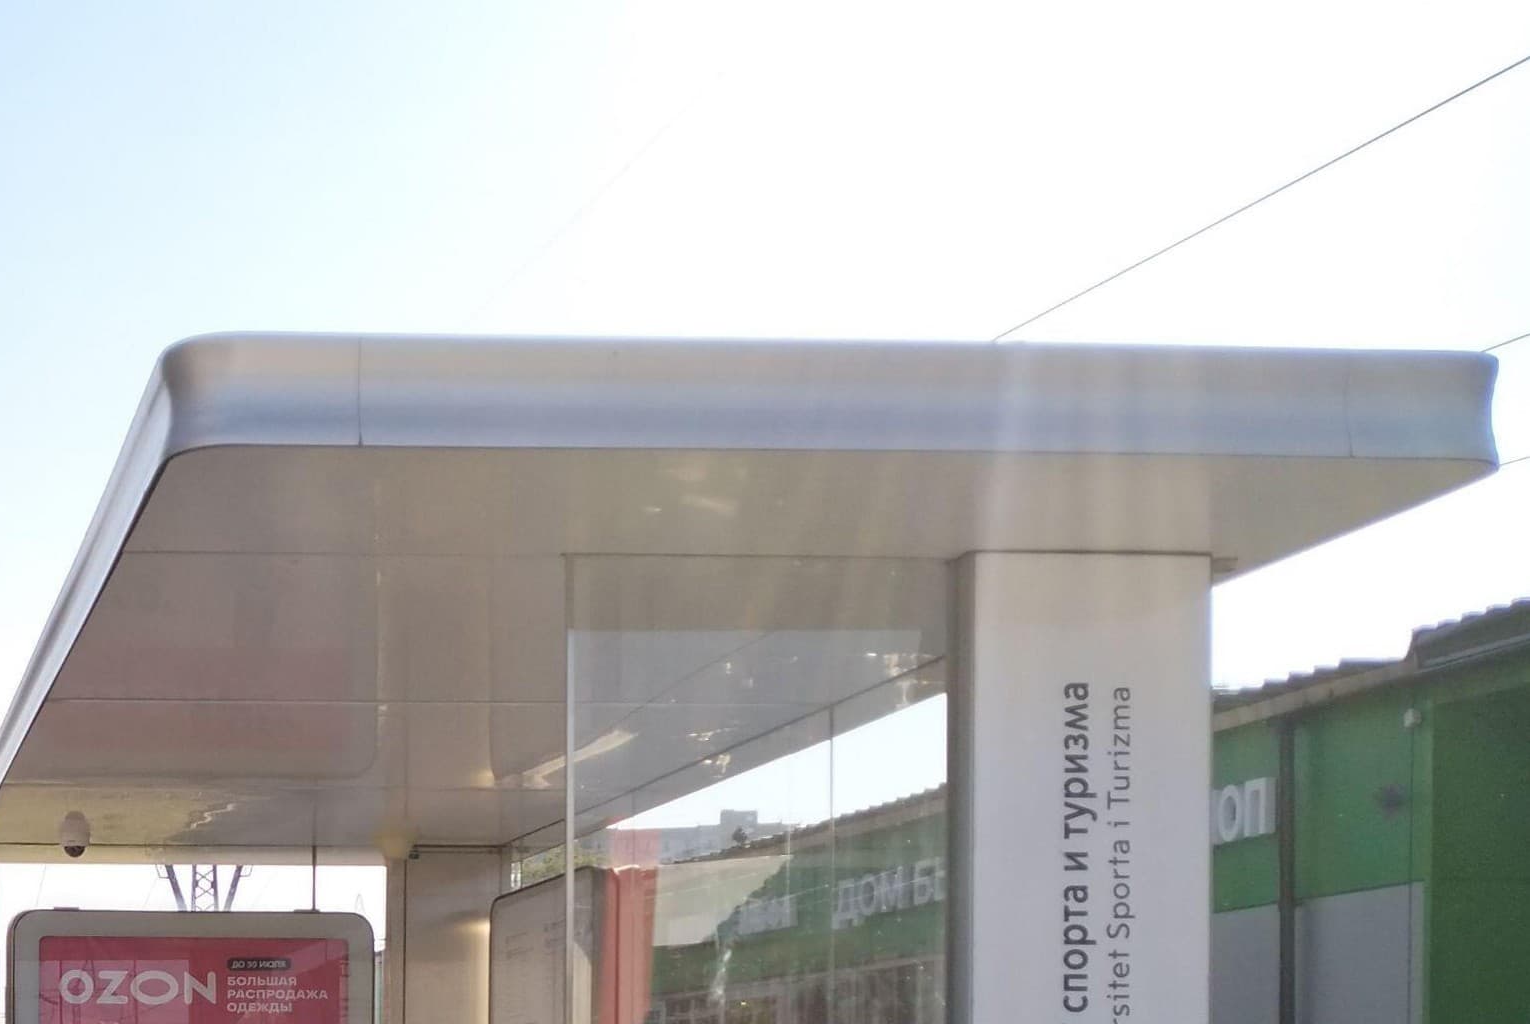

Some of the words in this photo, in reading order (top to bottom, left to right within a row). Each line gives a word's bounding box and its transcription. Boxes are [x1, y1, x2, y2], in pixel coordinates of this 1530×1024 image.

[1063, 682, 1098, 840] туризма
[1106, 686, 1131, 810] Turizma
[1063, 851, 1089, 872] и
[1106, 839, 1136, 940] Sporta
[1063, 885, 1097, 1013] спорта
[232, 960, 245, 969] ДО
[59, 969, 217, 1005] OZON
[226, 976, 297, 986] БОЛЬШАЯ
[226, 989, 329, 1001] РАСПРОДАЖА
[226, 1002, 293, 1013] ОДЕЖДЫ
